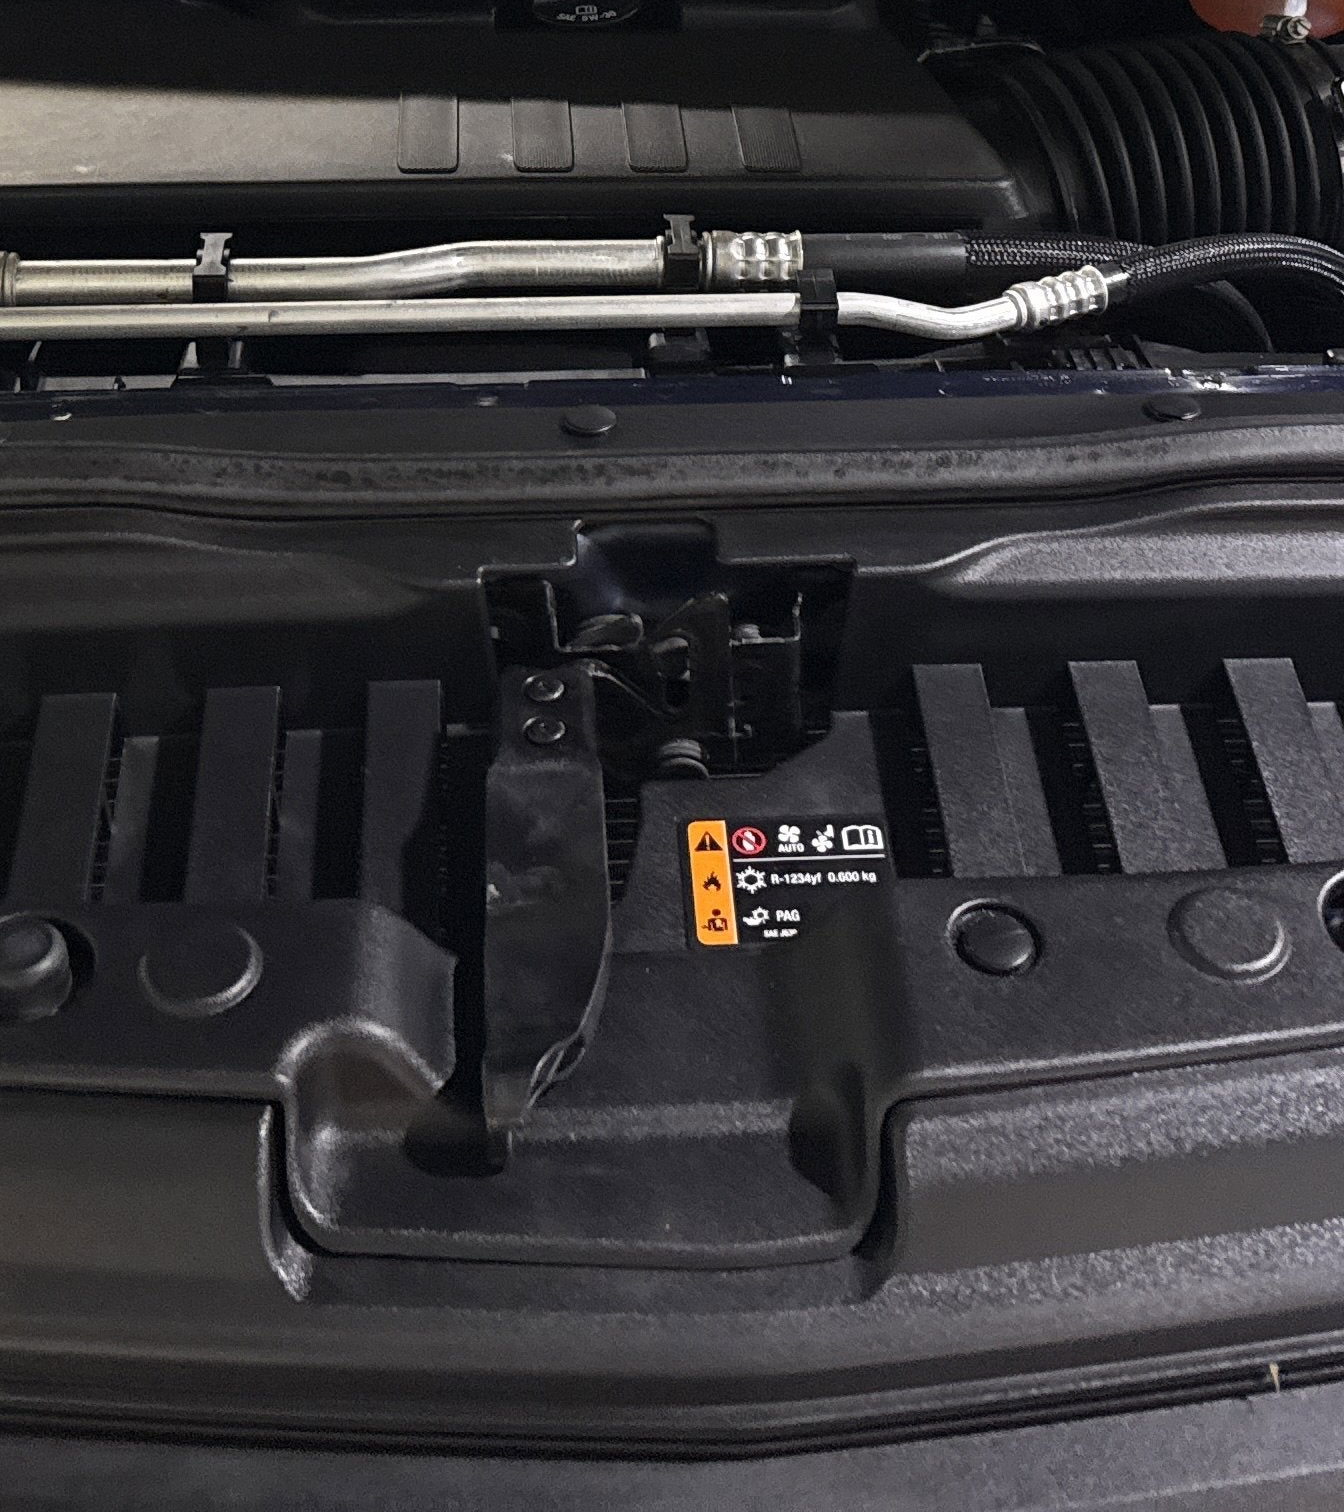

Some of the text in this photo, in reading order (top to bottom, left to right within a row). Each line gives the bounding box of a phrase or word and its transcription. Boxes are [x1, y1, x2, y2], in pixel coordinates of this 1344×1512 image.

[778, 843, 805, 853] AUTO
[770, 872, 822, 886] R-1234yf
[861, 870, 877, 883] kg
[775, 909, 801, 922] PAG
